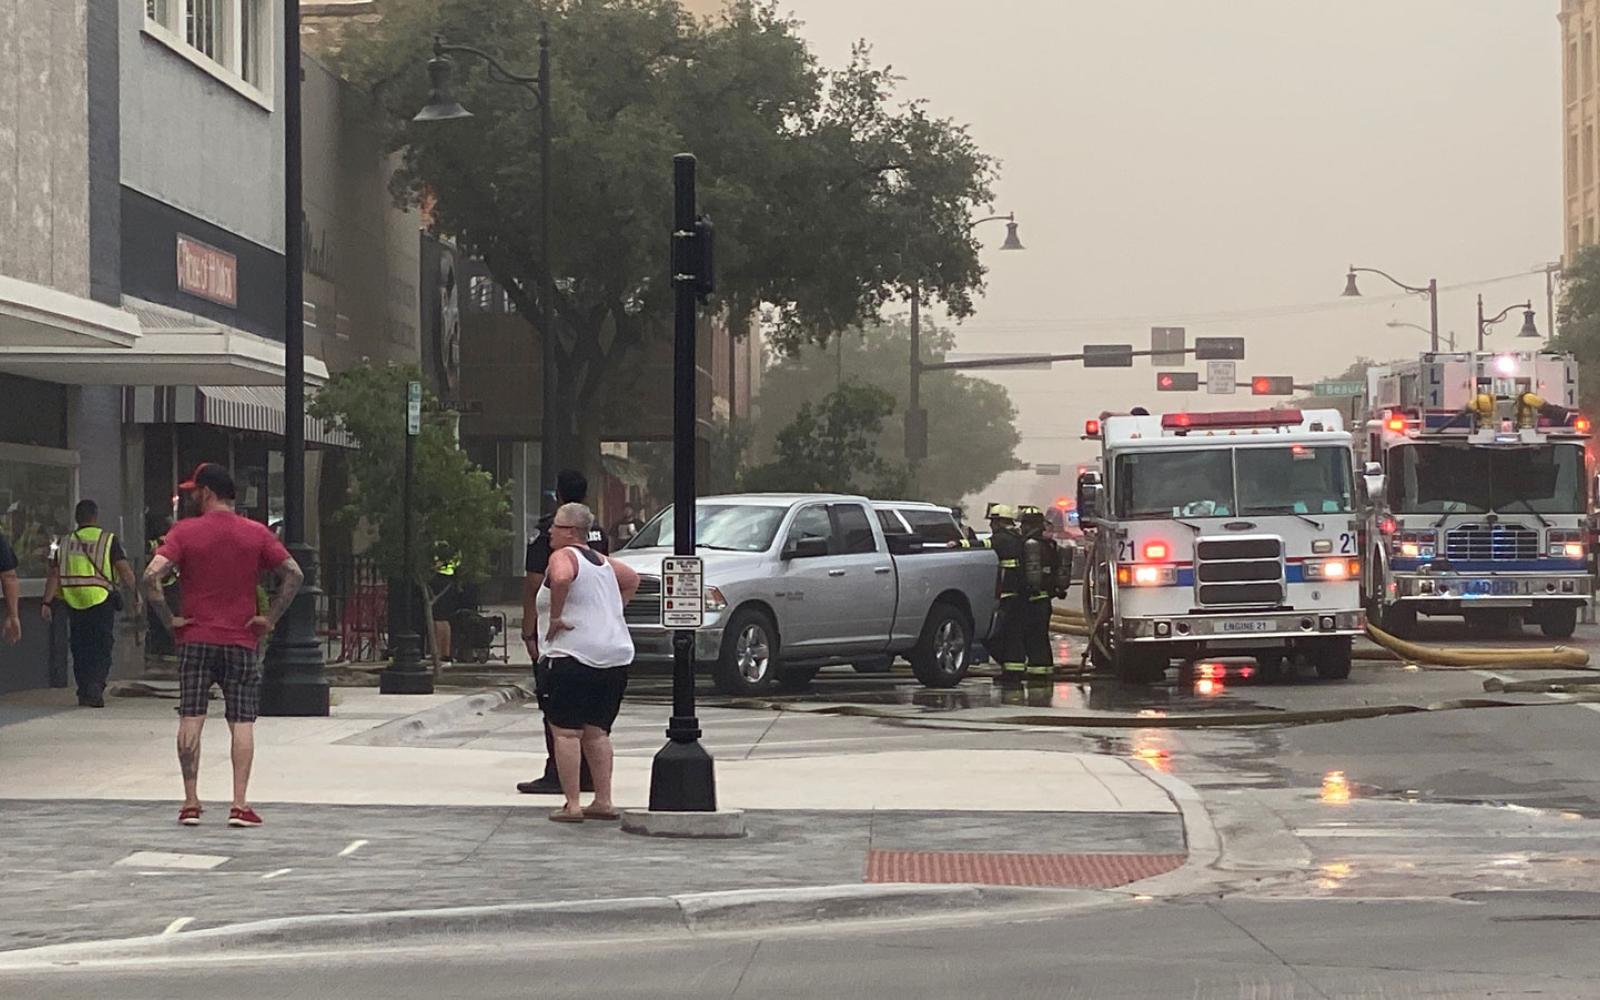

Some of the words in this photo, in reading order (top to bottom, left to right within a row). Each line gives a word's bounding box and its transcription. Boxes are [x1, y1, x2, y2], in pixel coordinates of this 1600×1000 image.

[1430, 368, 1440, 384] L
[1566, 366, 1574, 384] L
[1430, 389, 1437, 406] 1
[1118, 540, 1135, 561] 21
[1339, 532, 1356, 553] 21
[1223, 622, 1254, 631] ENGINE
[1256, 622, 1266, 630] 21
